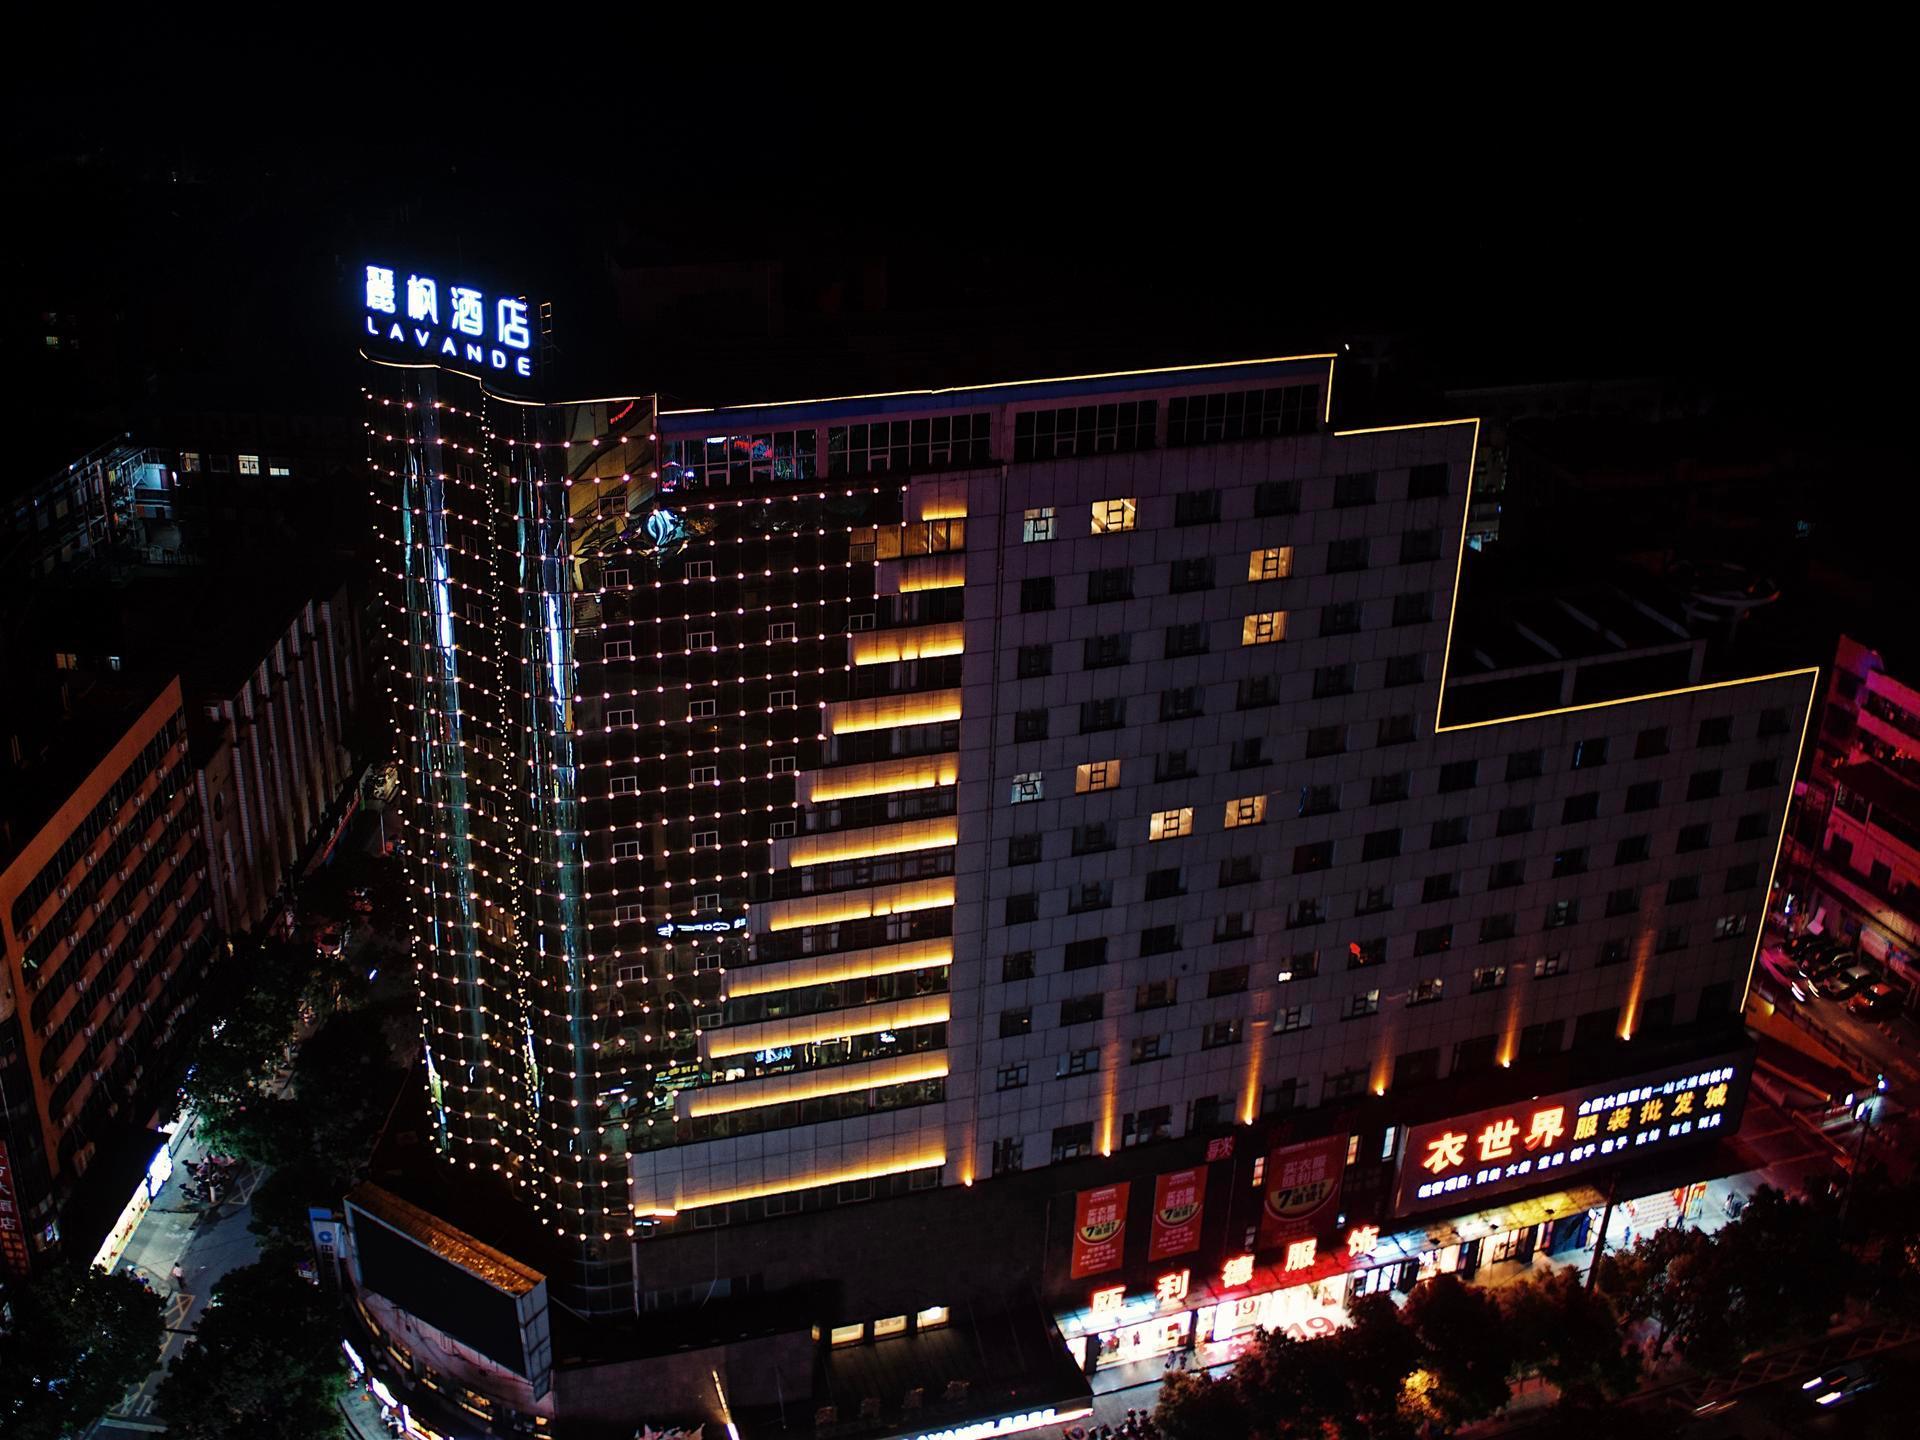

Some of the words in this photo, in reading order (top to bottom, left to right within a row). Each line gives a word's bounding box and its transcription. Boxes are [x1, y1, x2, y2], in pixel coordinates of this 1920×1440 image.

[367, 316, 531, 376] LAVANDE
[1422, 1104, 1566, 1176] 衣世界
[1573, 1083, 1728, 1141] 服装批发城
[1234, 1299, 1256, 1316] 19
